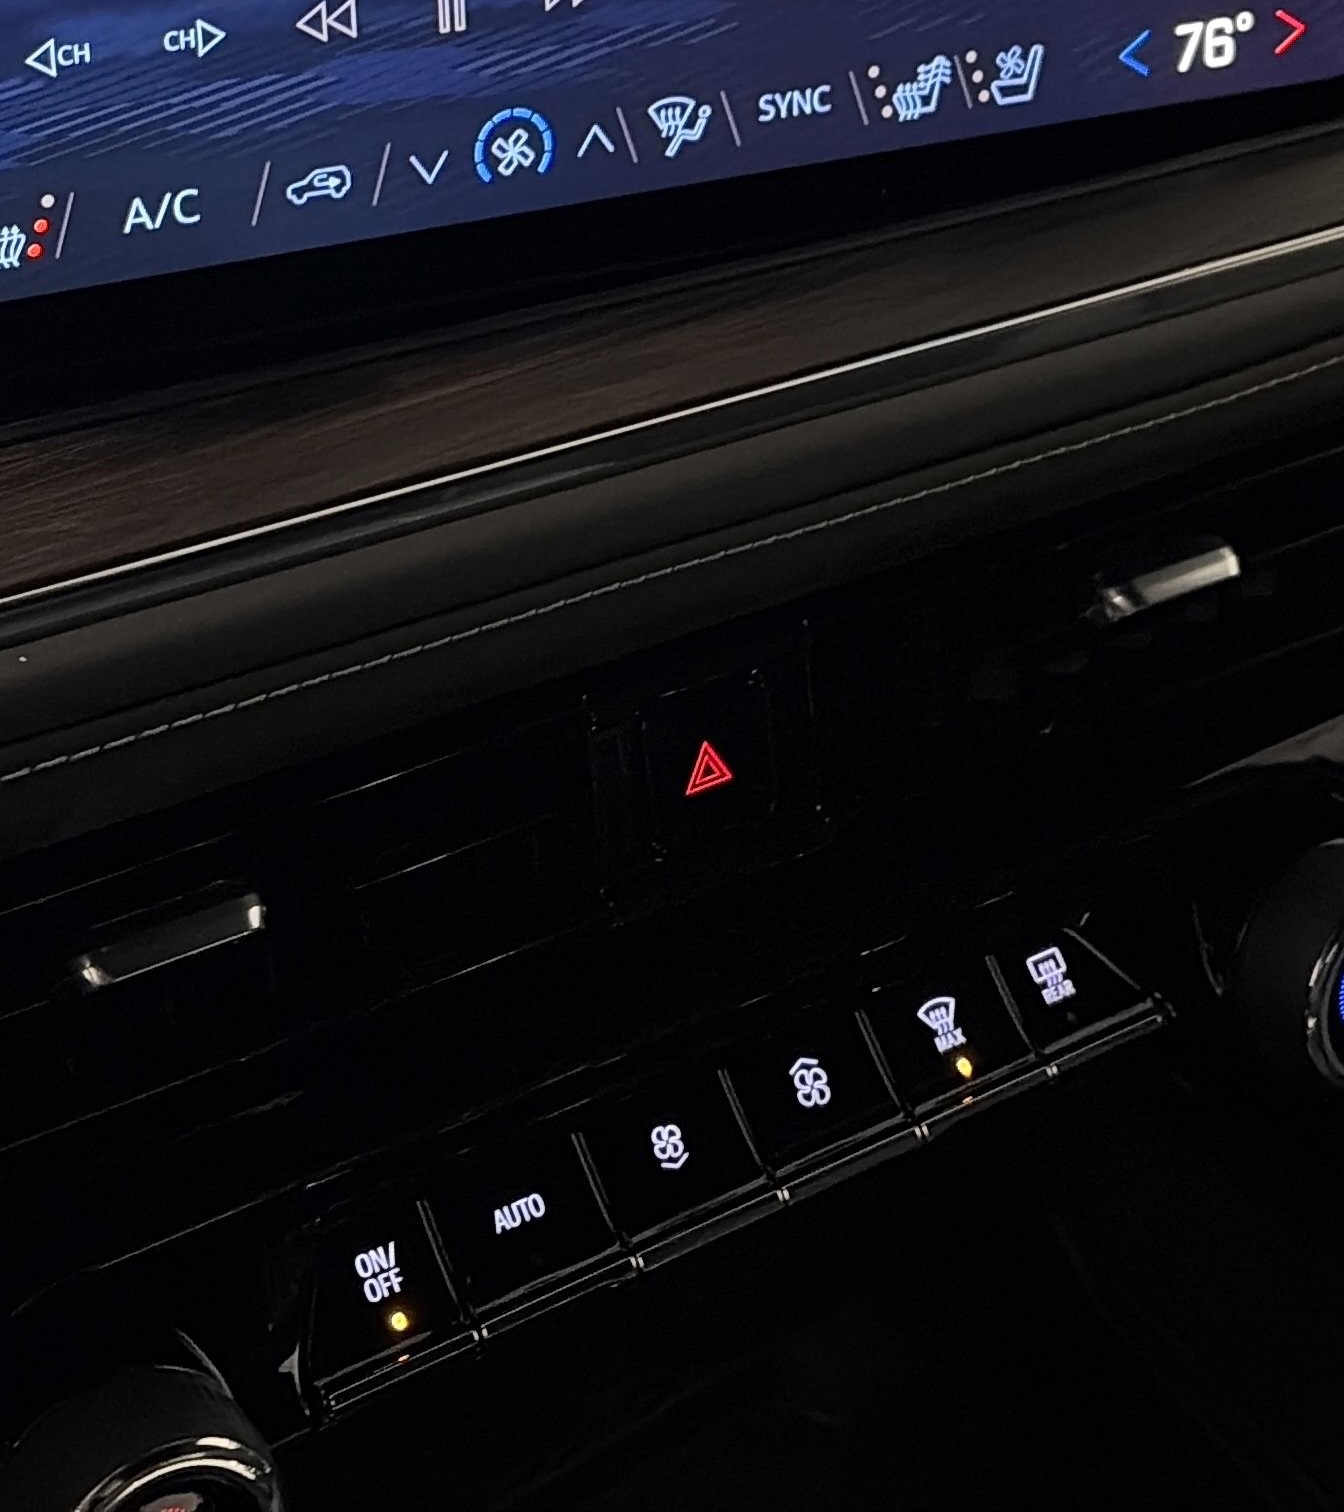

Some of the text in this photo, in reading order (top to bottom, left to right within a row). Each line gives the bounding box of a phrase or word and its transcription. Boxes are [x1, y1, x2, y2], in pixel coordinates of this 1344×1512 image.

[57, 42, 91, 67] CH
[163, 30, 196, 53] CH
[1173, 11, 1254, 73] 76°
[758, 84, 832, 122] SYNC
[123, 189, 201, 234] A/C
[494, 1193, 546, 1235] AUTO
[355, 1240, 396, 1278] ON/
[363, 1267, 404, 1303] OFF
